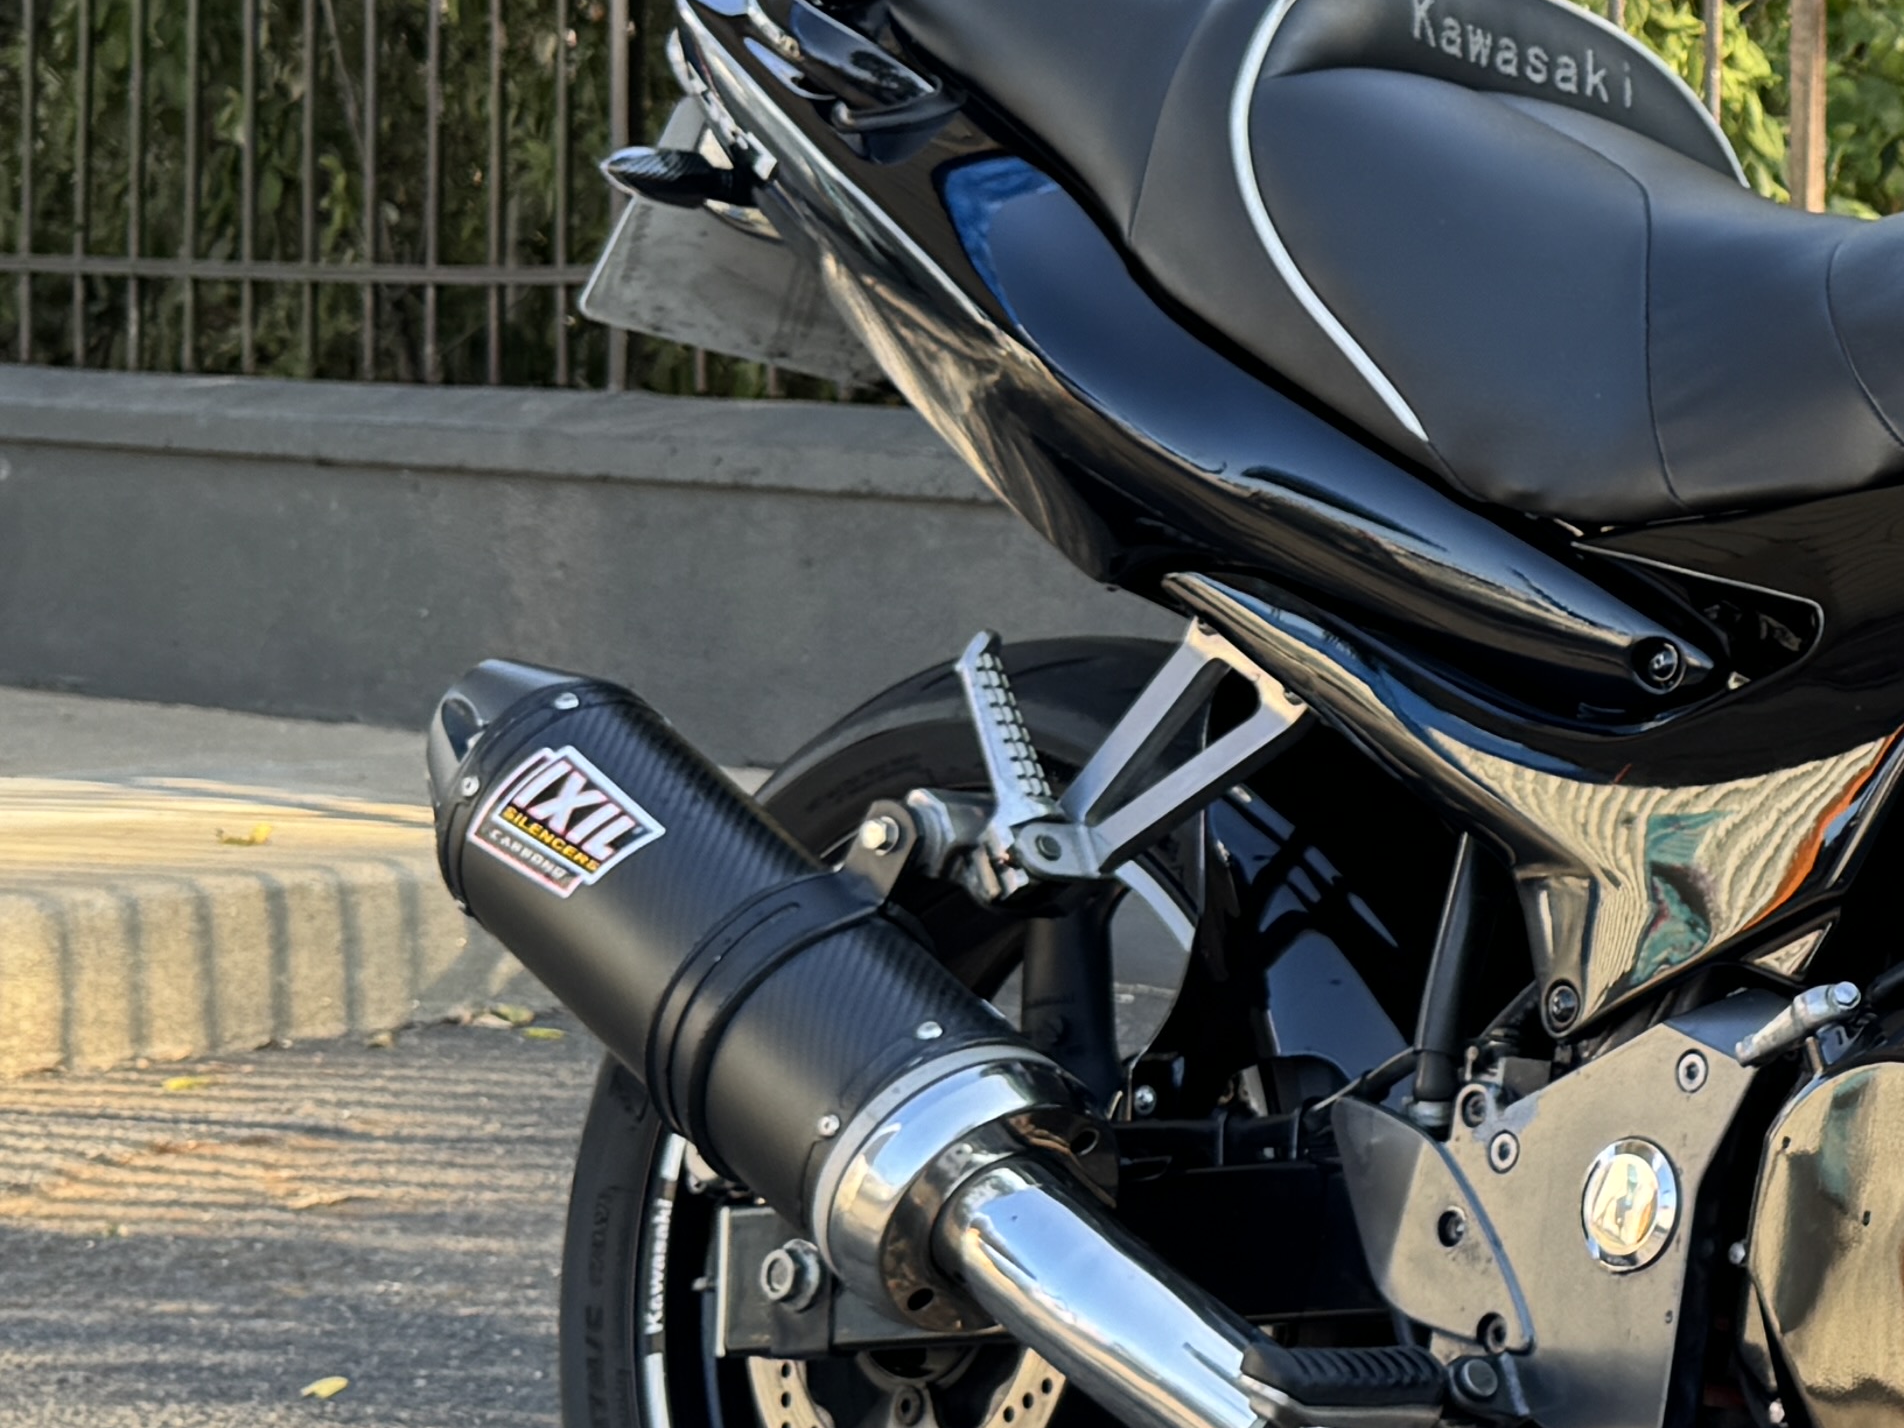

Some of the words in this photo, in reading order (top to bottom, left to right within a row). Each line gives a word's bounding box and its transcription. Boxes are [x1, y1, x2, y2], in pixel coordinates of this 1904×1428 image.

[501, 805, 601, 873] SILENCERS
[511, 759, 637, 862] IXIL
[644, 1197, 673, 1335] Kawasaki
